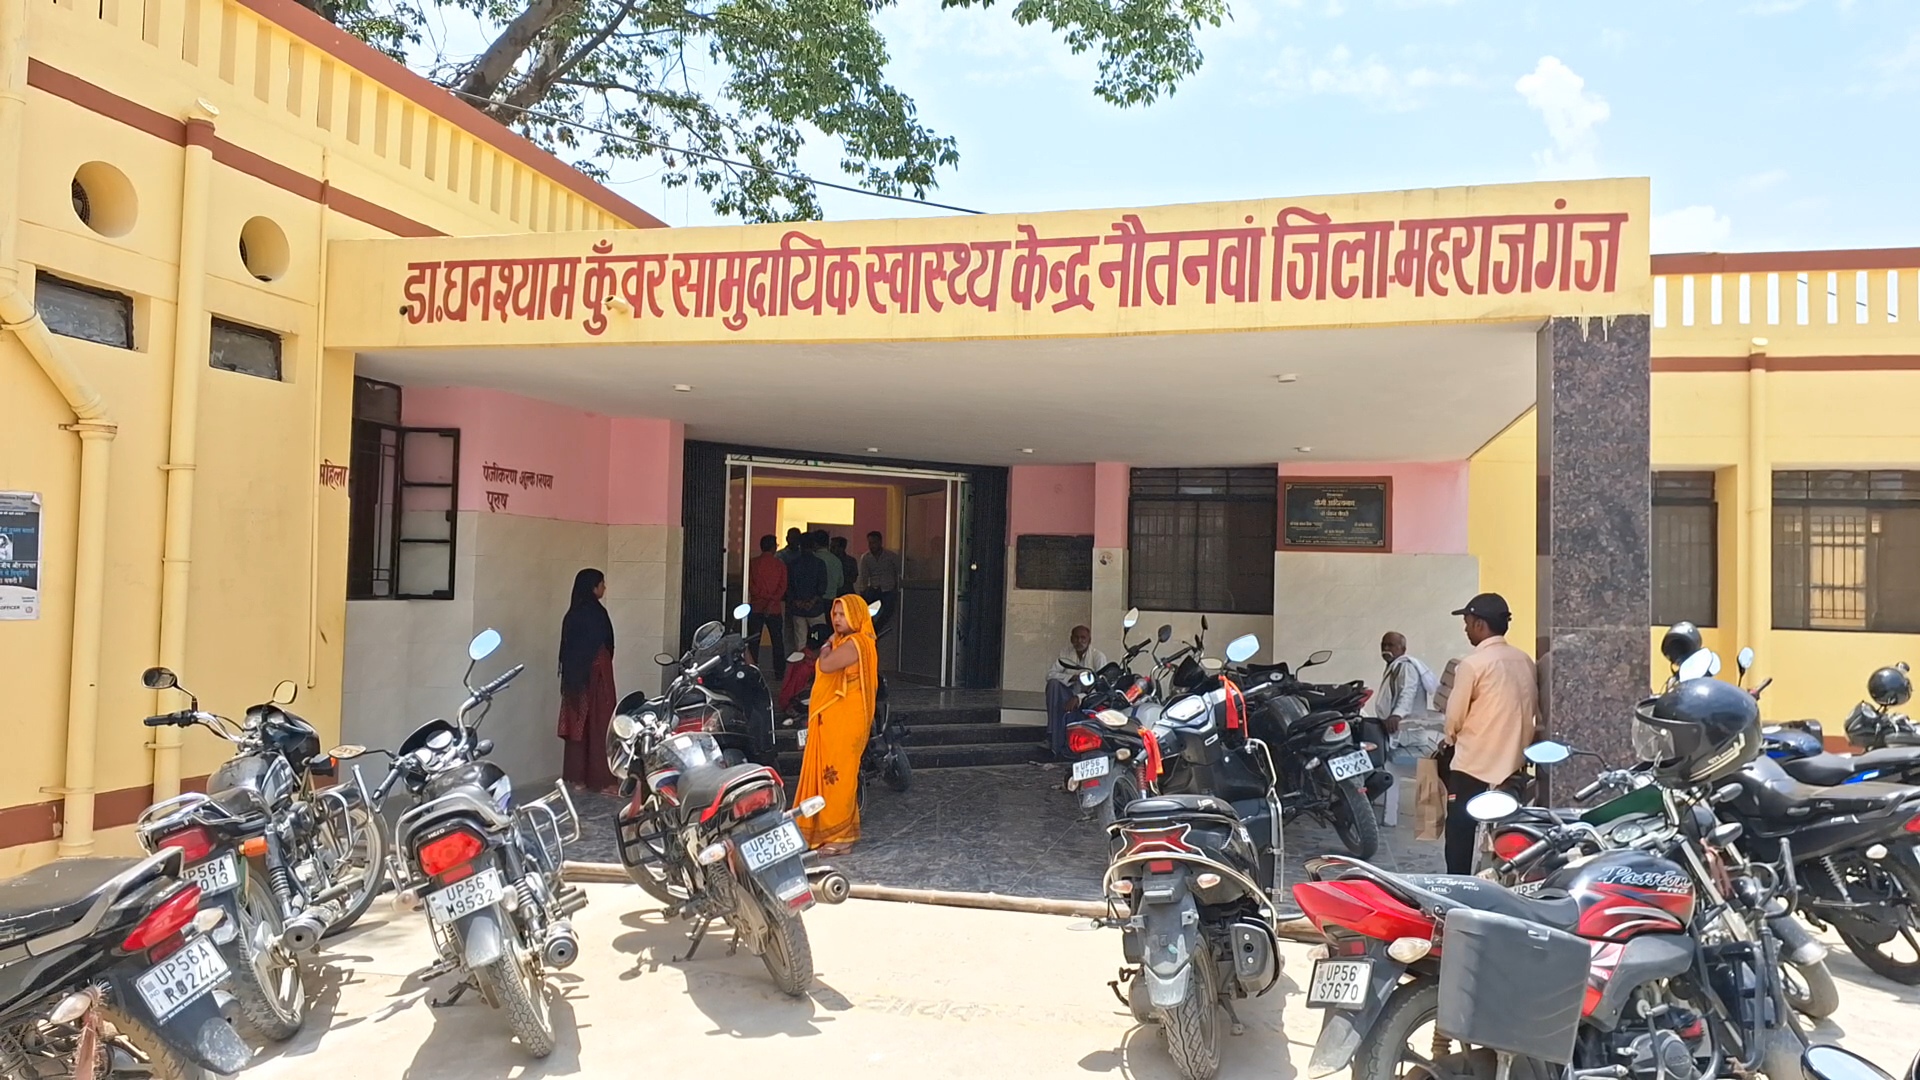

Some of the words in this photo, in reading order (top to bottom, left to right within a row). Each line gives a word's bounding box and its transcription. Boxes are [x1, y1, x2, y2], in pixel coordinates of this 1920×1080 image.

[443, 256, 582, 323] घनश्याम
[582, 239, 669, 336] कुँवर
[671, 230, 861, 331] सामुदायिक
[865, 240, 1011, 315] स्वास्थ्य
[1010, 224, 1100, 314] केन्द्र
[1099, 213, 1267, 308] नौतनवां
[485, 490, 510, 513] पुरुष
[1080, 759, 1101, 770] UP56
[749, 826, 790, 853] UP56A
[755, 838, 796, 865] C5485
[446, 877, 486, 901] UP56
[1599, 865, 1693, 889] Passion
[1656, 885, 1689, 895] PRO
[445, 889, 495, 919] M9532
[154, 945, 211, 986] UP56A
[1326, 964, 1358, 982] UP56
[164, 963, 220, 1006] R0244
[1319, 982, 1359, 1001] S7670
